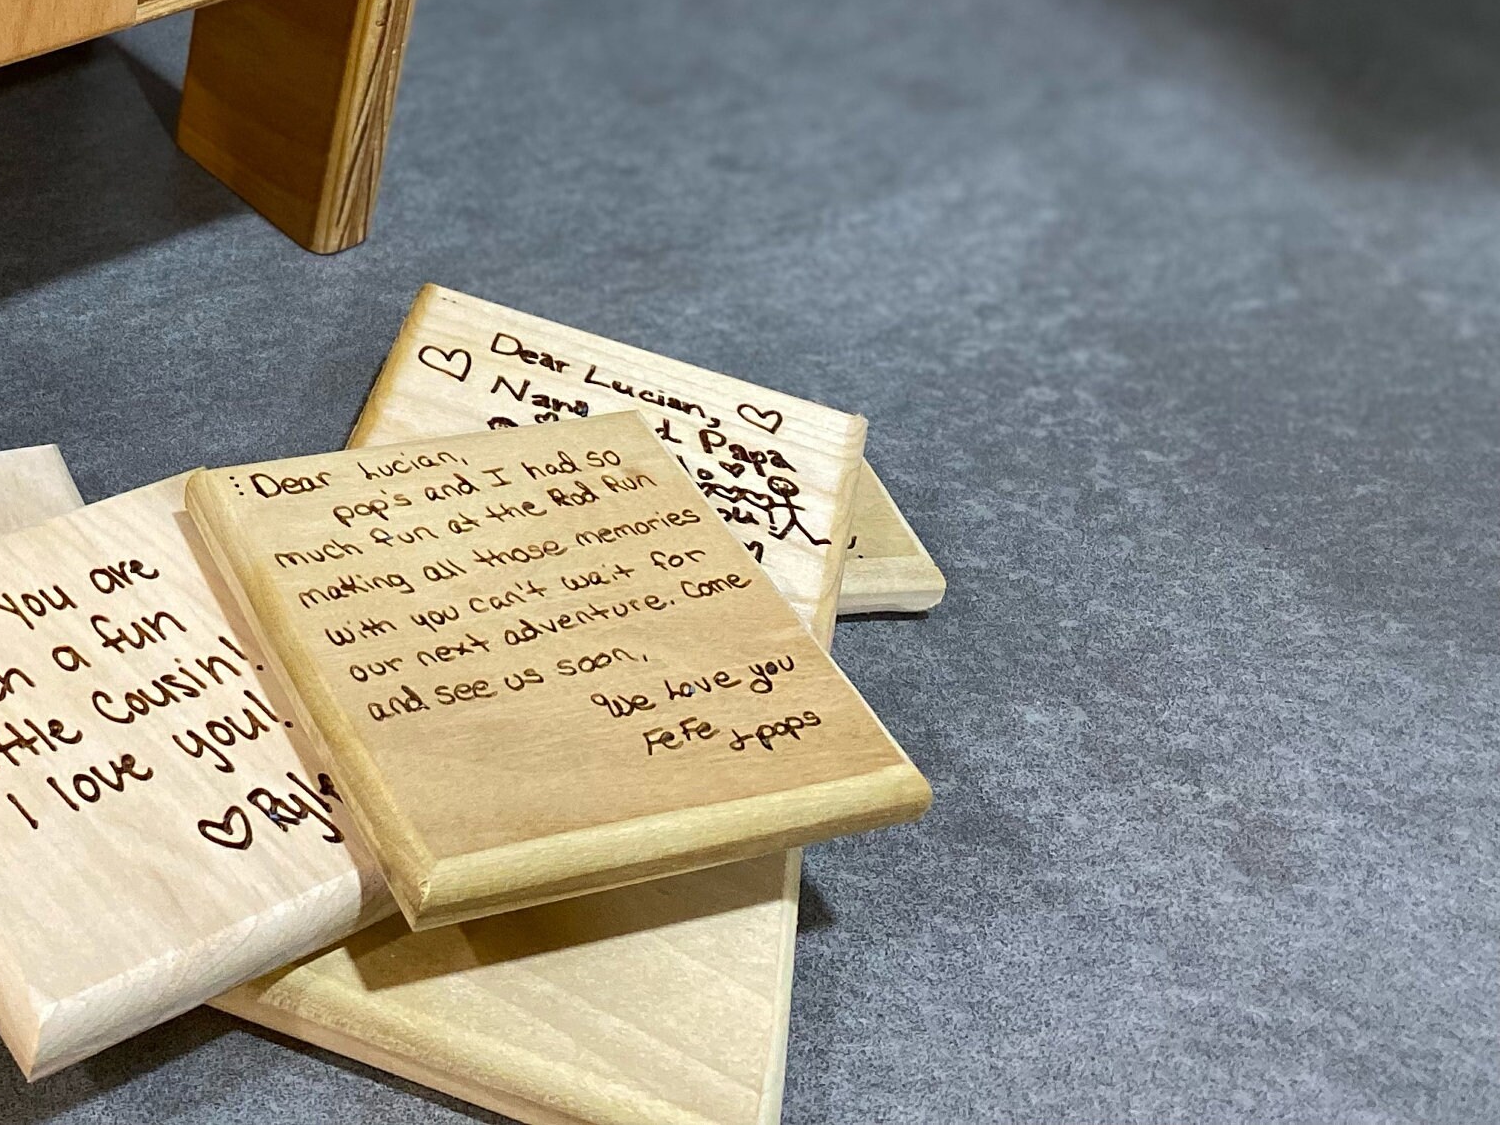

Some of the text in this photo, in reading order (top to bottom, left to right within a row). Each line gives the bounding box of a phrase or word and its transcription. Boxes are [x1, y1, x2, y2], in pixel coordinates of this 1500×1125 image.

[490, 332, 721, 428] Dear Lucian,
[490, 375, 589, 418] Nana
[249, 451, 468, 499] Dear Lucian,
[698, 428, 797, 477] Papa
[333, 450, 621, 527] pop's and I had so
[274, 539, 363, 569] much
[369, 526, 439, 547] fun
[448, 512, 480, 534] at
[485, 501, 547, 523] the
[298, 508, 701, 610] making all those memories
[90, 559, 160, 595] are
[410, 606, 459, 633] you
[469, 579, 548, 614] can't
[561, 563, 635, 592] wait
[650, 549, 706, 571] for
[52, 645, 92, 672] a
[90, 610, 188, 654] fun
[350, 657, 403, 683] our
[417, 633, 490, 667] next
[504, 595, 675, 646] adventure.
[748, 655, 795, 694] you
[367, 647, 648, 722] and see us soon,
[6, 690, 293, 830] I love you!
